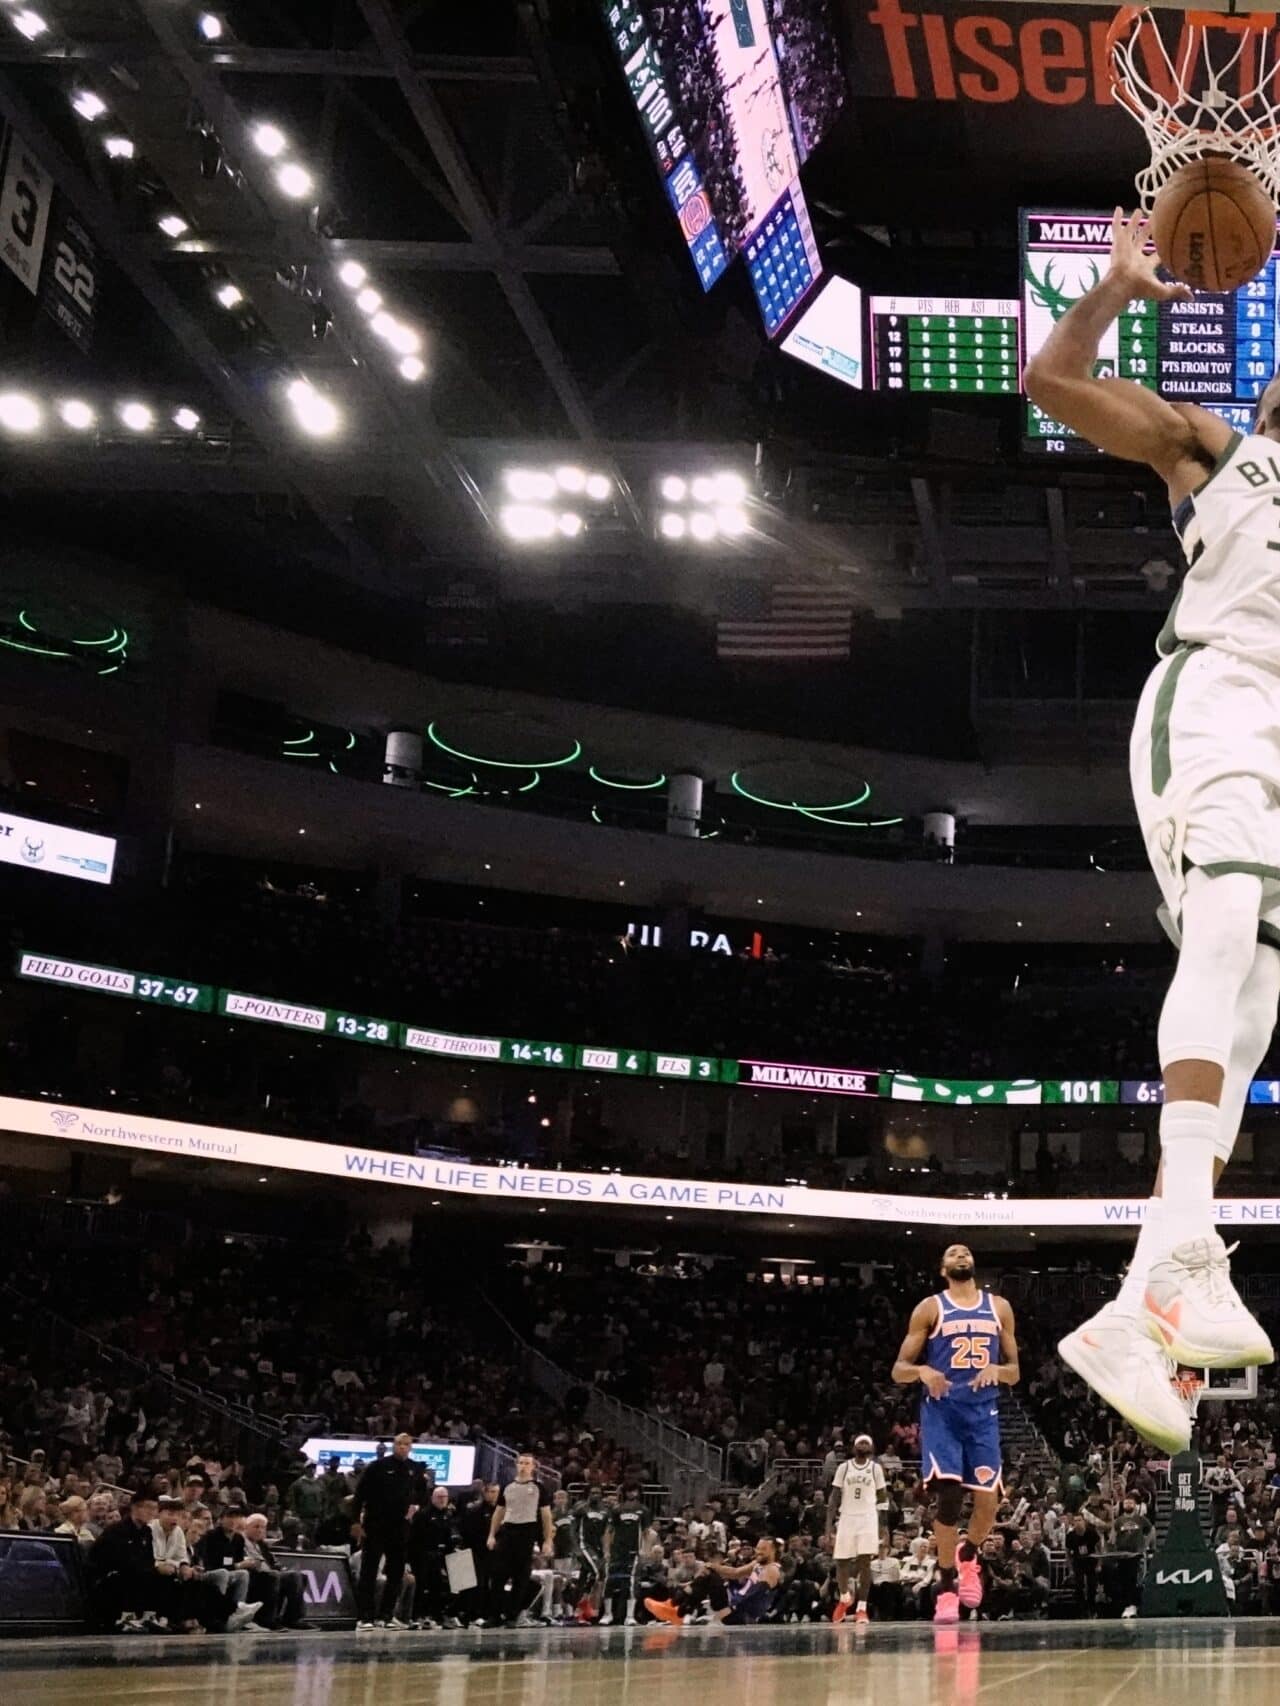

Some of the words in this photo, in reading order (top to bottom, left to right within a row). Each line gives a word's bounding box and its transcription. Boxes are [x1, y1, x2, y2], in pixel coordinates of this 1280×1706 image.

[646, 88, 672, 134] 101
[672, 162, 697, 205] 103
[12, 180, 38, 247] 3
[1039, 222, 1112, 242] MILWA
[54, 241, 95, 315] 22
[1247, 281, 1266, 296] 23
[1127, 300, 1147, 314] 24
[1170, 302, 1225, 315] ASSISTS
[1247, 303, 1265, 317] 21
[948, 317, 956, 328] 2
[1131, 319, 1143, 334] 4
[1171, 323, 1223, 335] STEALS
[1131, 339, 1143, 353] 6
[1169, 342, 1225, 354] BLOCKS
[1251, 342, 1260, 357] 2
[1129, 359, 1147, 373] 13
[1161, 361, 1180, 372] PTS
[1181, 361, 1209, 373] FROM
[1211, 362, 1232, 374] TOV
[1247, 362, 1265, 376] 10
[1162, 381, 1232, 394] CHALLENGES
[1252, 382, 1259, 396] 1
[1046, 440, 1065, 452] FG
[25, 958, 74, 979] FIELD
[77, 969, 131, 990] GOALS
[138, 978, 199, 1004] 37-67
[228, 998, 322, 1027] 3-POINTERS
[336, 1016, 389, 1041] 13-28
[409, 1033, 440, 1048] FREE
[441, 1038, 496, 1055] THROWS
[511, 1044, 564, 1063] 14-16
[586, 1053, 613, 1066] TOL
[625, 1055, 638, 1070] 4
[660, 1060, 687, 1073] FLS
[699, 1062, 710, 1076] 3
[751, 1065, 866, 1091] MILWAUKEE
[1060, 1081, 1100, 1103] 101
[82, 1123, 183, 1148] Northwestern
[188, 1137, 238, 1155] Mutual
[344, 1154, 426, 1181] WHEN
[434, 1167, 489, 1190] LIFE
[498, 1174, 593, 1197] NEEDS
[602, 1181, 620, 1197] A
[629, 1184, 709, 1203] GAME
[717, 1189, 785, 1208] PLAN
[894, 1206, 971, 1221] Northwestern
[974, 1210, 1015, 1221] Mutual
[1104, 1206, 1147, 1219] WH
[950, 1336, 991, 1369] 25
